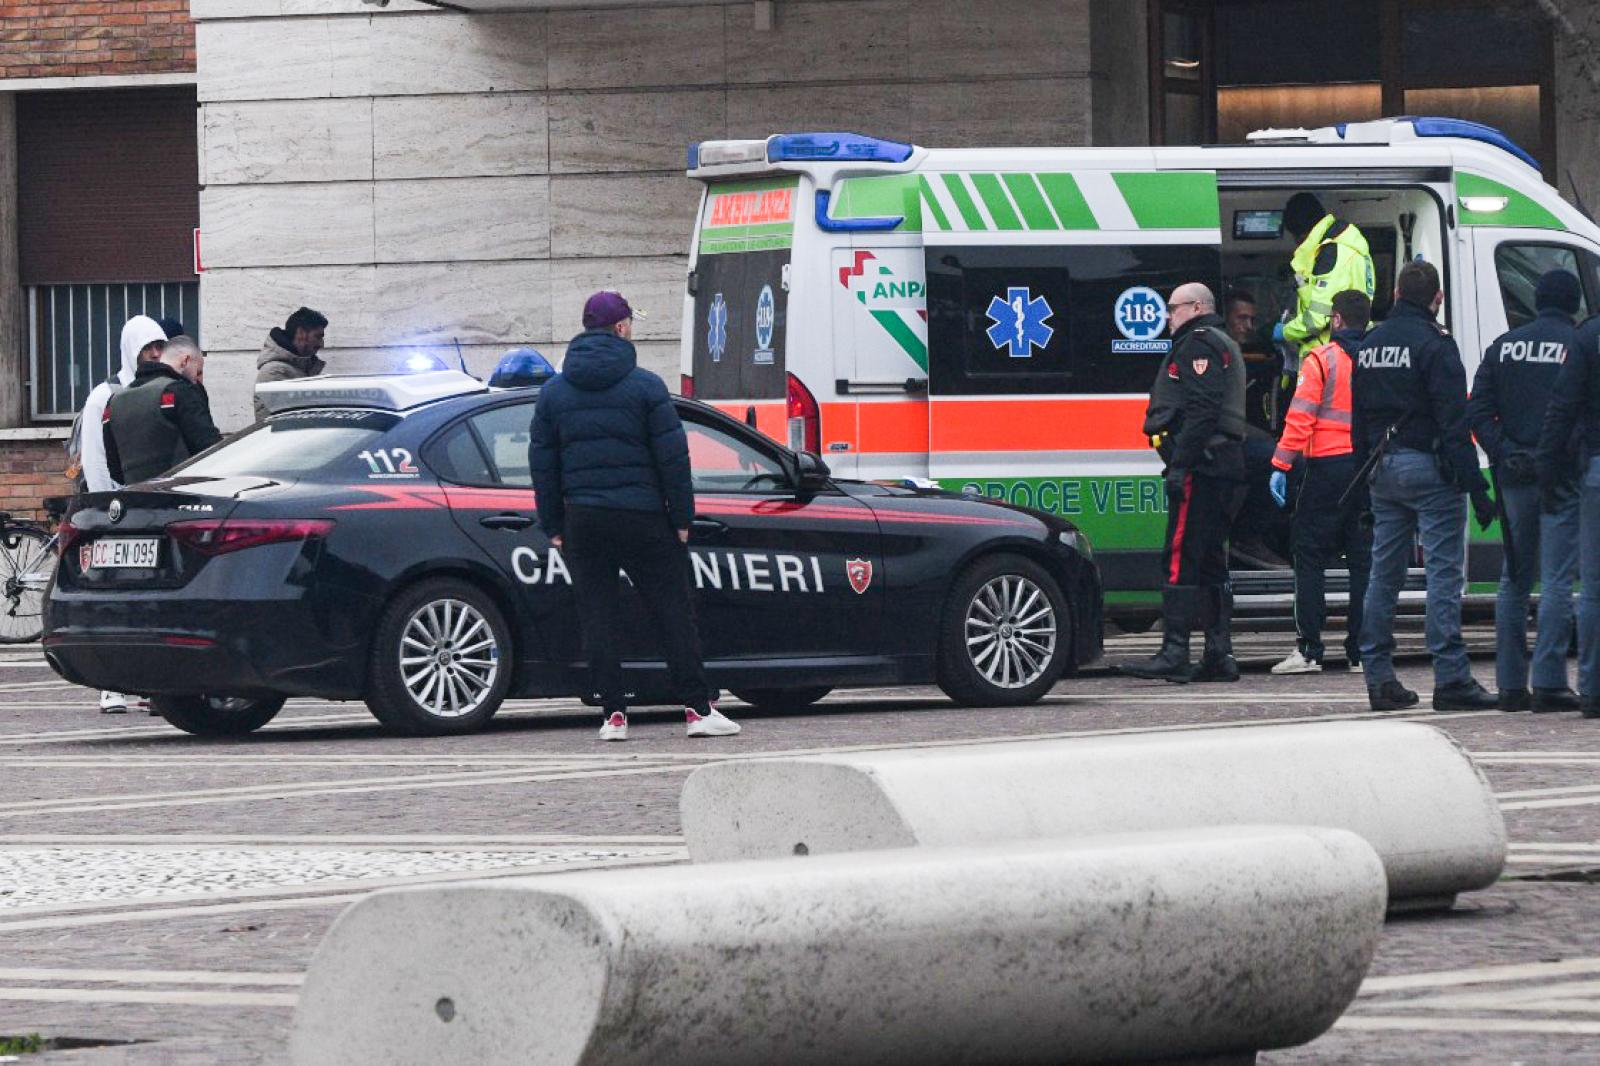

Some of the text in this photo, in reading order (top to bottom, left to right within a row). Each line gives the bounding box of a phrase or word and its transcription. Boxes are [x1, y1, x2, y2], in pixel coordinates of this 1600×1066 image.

[872, 281, 927, 299] ANP
[1123, 303, 1157, 323] 118
[1114, 342, 1169, 351] ACCREDITATO
[1358, 346, 1411, 369] POLIZIA
[357, 447, 419, 473] 112
[1089, 479, 1169, 515] VER
[94, 544, 108, 564] CC
[113, 543, 130, 564] EN
[511, 546, 825, 593] CANIERI
